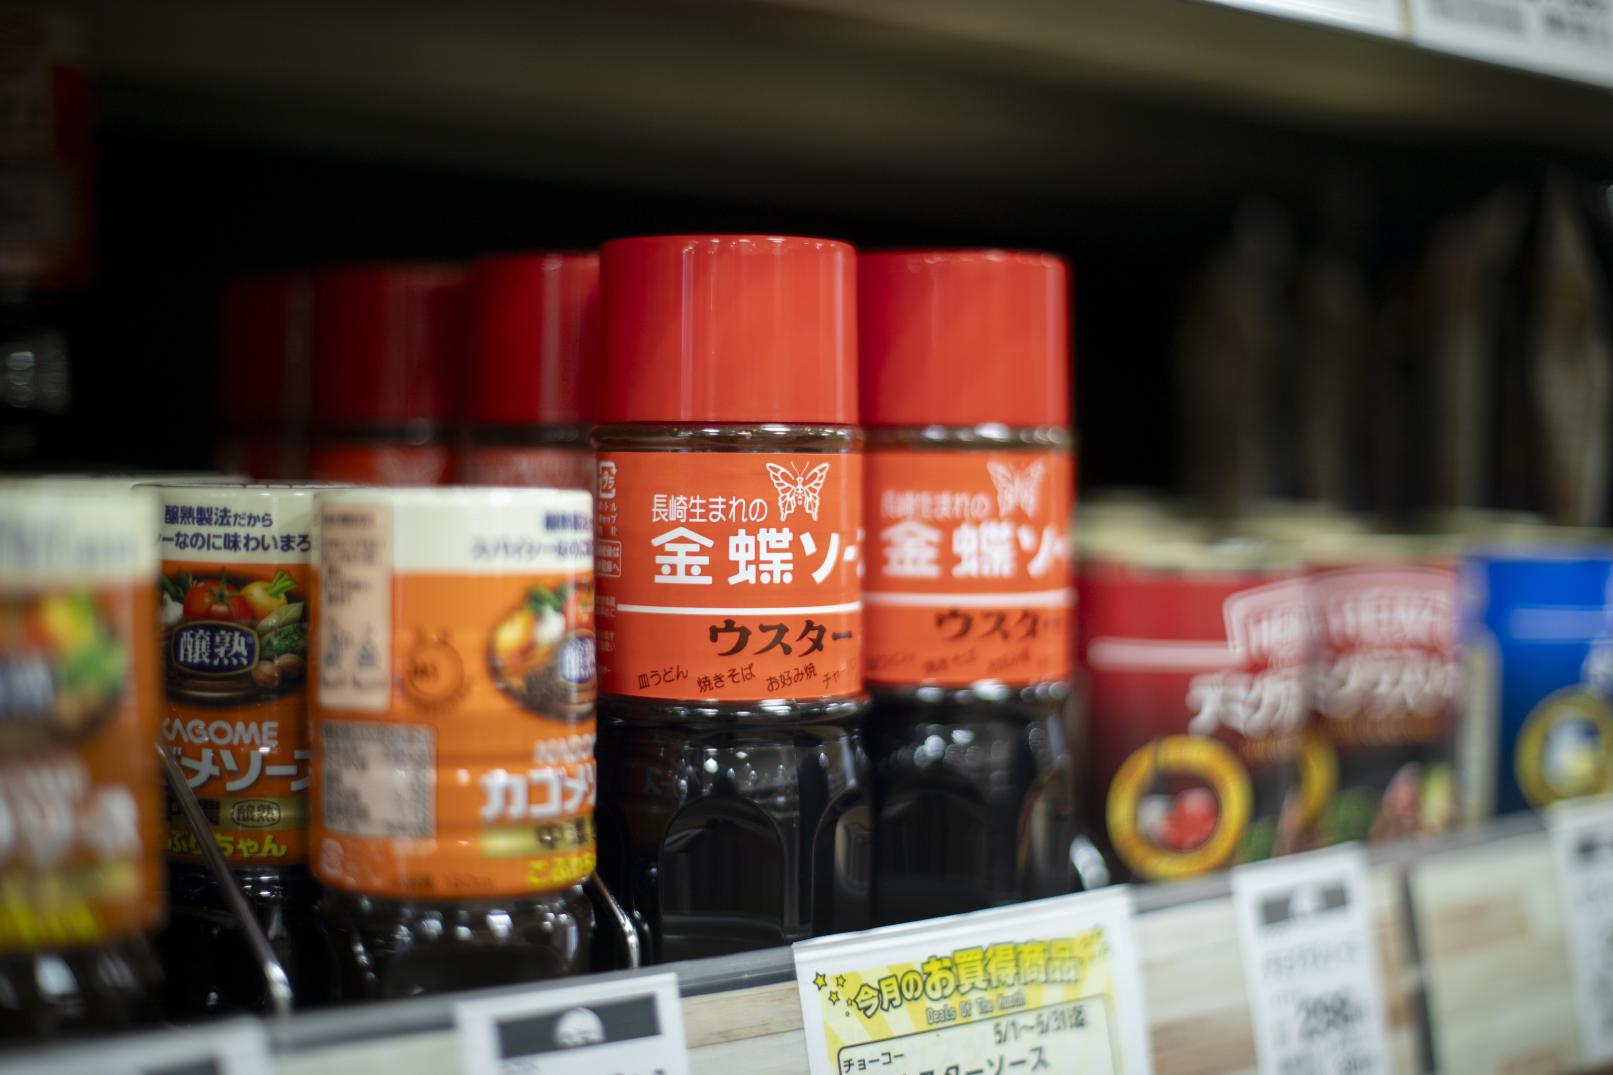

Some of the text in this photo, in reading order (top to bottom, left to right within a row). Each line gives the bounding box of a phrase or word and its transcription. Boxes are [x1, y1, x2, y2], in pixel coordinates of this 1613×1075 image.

[164, 505, 274, 527] 醸熟製法だから
[651, 494, 768, 523] 長崎生まれの
[157, 532, 312, 553] ーなのに味わいまろ
[651, 526, 863, 585] 金蝶ソー
[179, 629, 249, 666] 醸熟
[709, 619, 853, 658] ウスター
[638, 664, 689, 690] 皿うどん
[697, 663, 756, 694] 焼きそば
[766, 662, 818, 693] お好み焼
[171, 747, 311, 792] メソー
[854, 941, 1079, 1018] 今月のお買得商品
[843, 1052, 905, 1074] チョーコー
